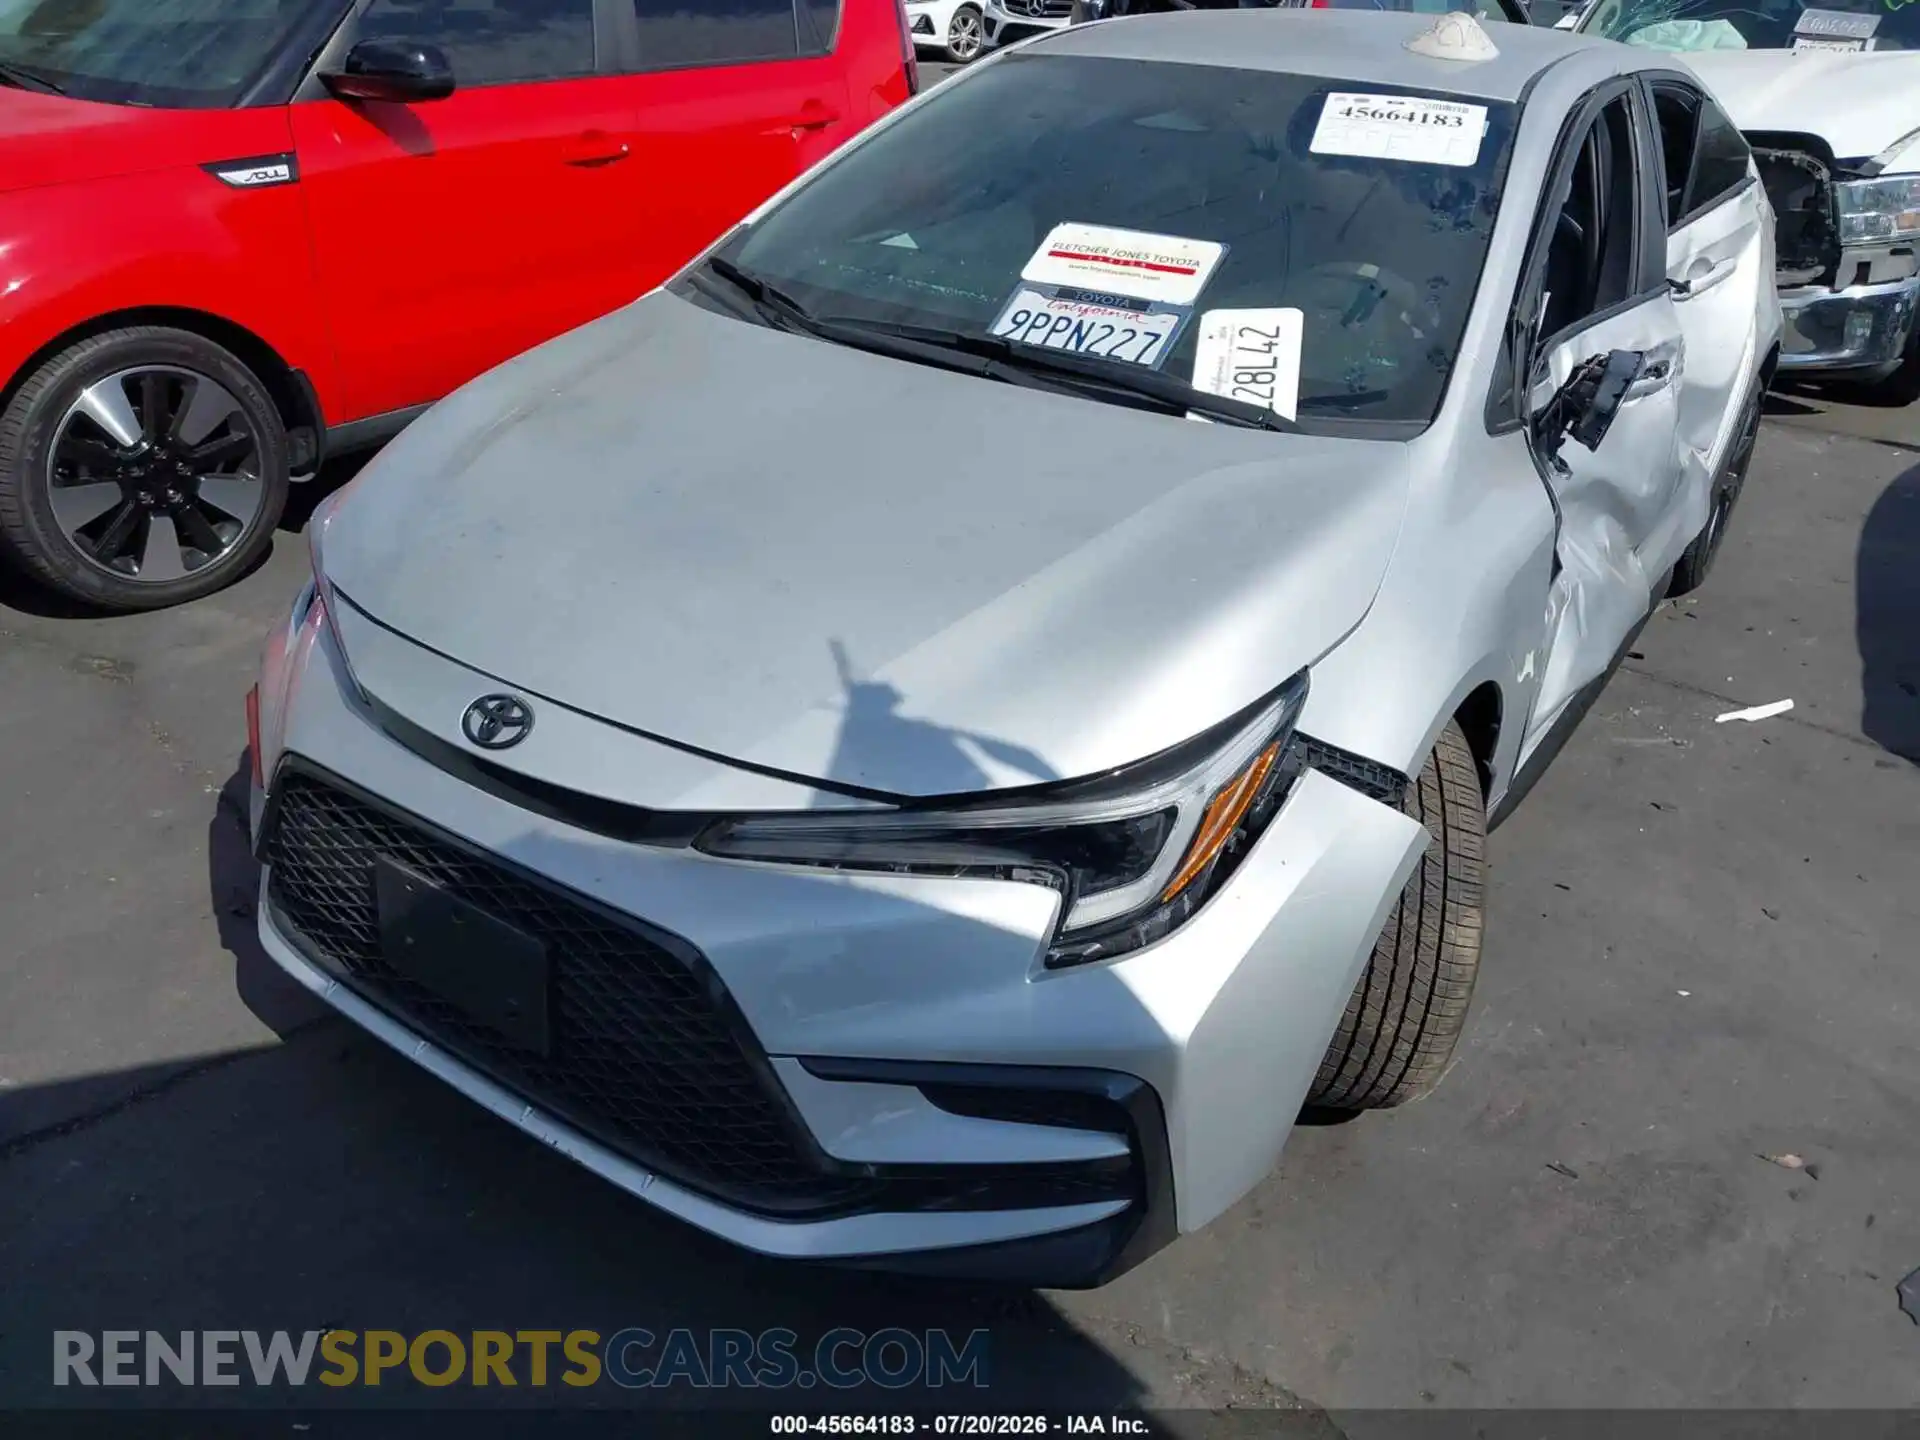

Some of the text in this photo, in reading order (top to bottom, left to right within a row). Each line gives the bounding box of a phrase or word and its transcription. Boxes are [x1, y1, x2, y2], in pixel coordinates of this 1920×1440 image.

[1339, 106, 1464, 128] 45664183
[1052, 241, 1109, 255] FLETCHER
[1111, 249, 1151, 261] JONES
[1153, 253, 1201, 268] TOYOTA
[1075, 291, 1130, 308] TOYOTA
[1002, 308, 1163, 363] 9PPN227
[1231, 325, 1281, 410] 28L42
